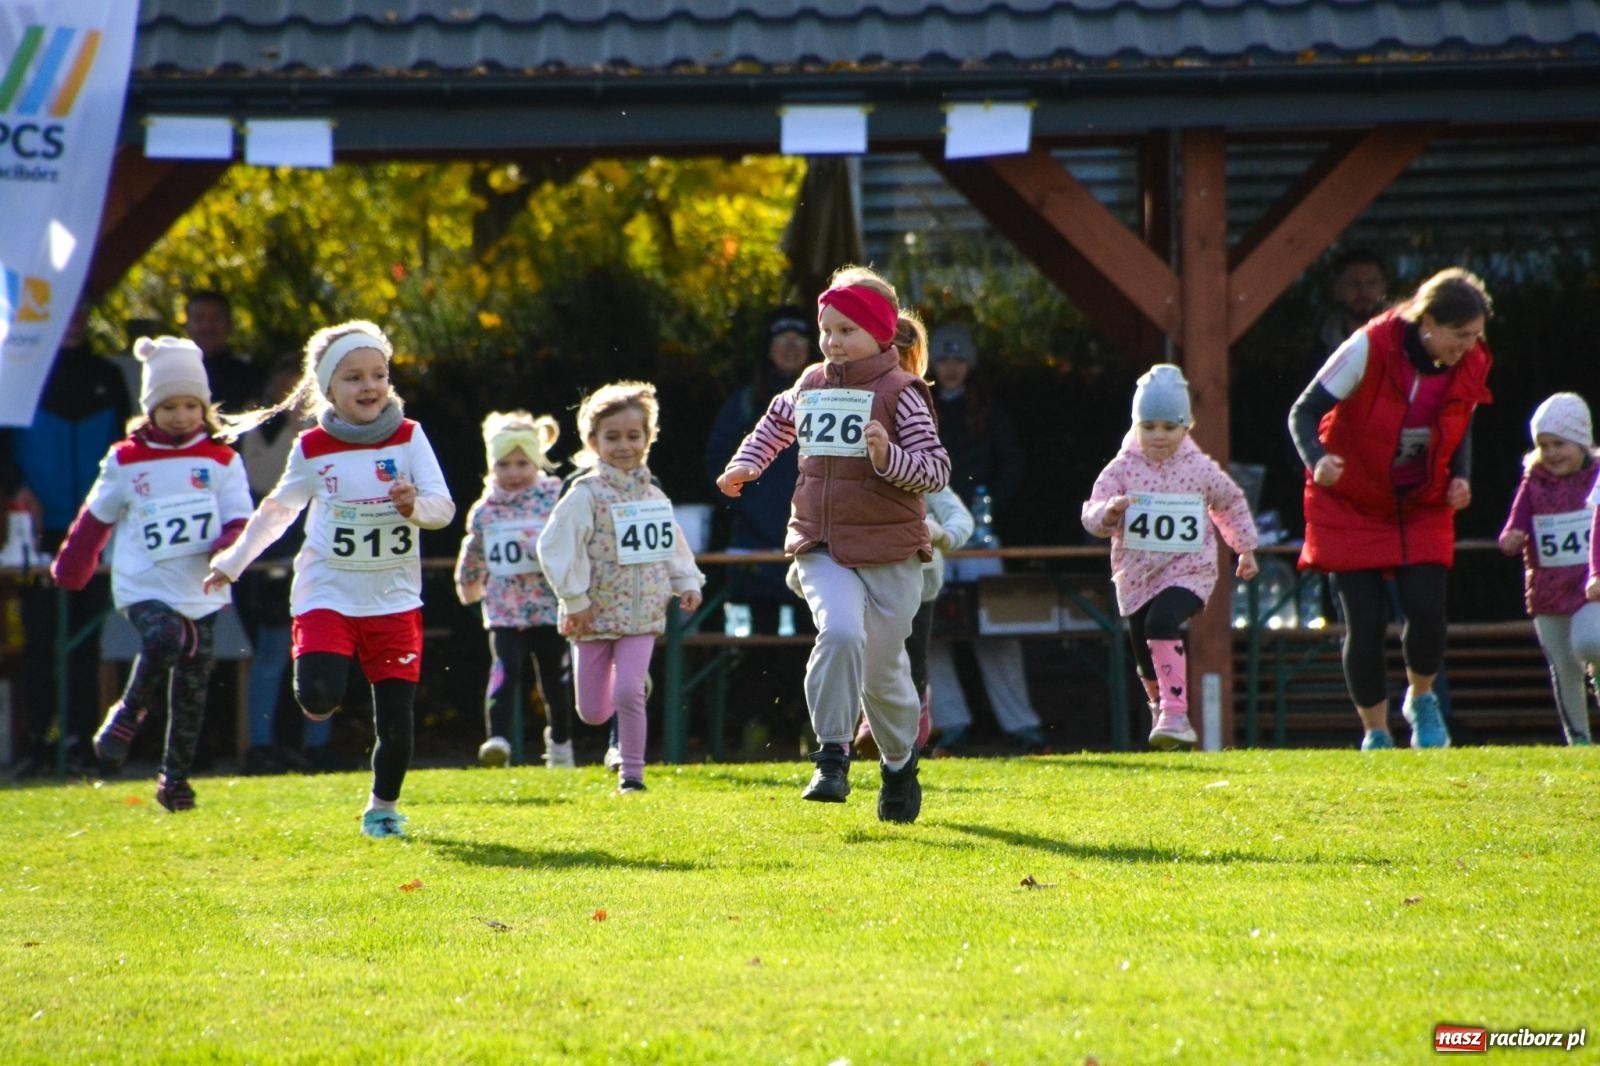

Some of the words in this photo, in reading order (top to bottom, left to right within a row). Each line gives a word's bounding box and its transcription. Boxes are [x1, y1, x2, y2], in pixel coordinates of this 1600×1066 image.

[798, 412, 864, 444] 426
[143, 512, 213, 550] 527
[332, 525, 412, 558] 513
[621, 521, 673, 552] 405
[1128, 512, 1198, 542] 403
[489, 540, 537, 565] 40
